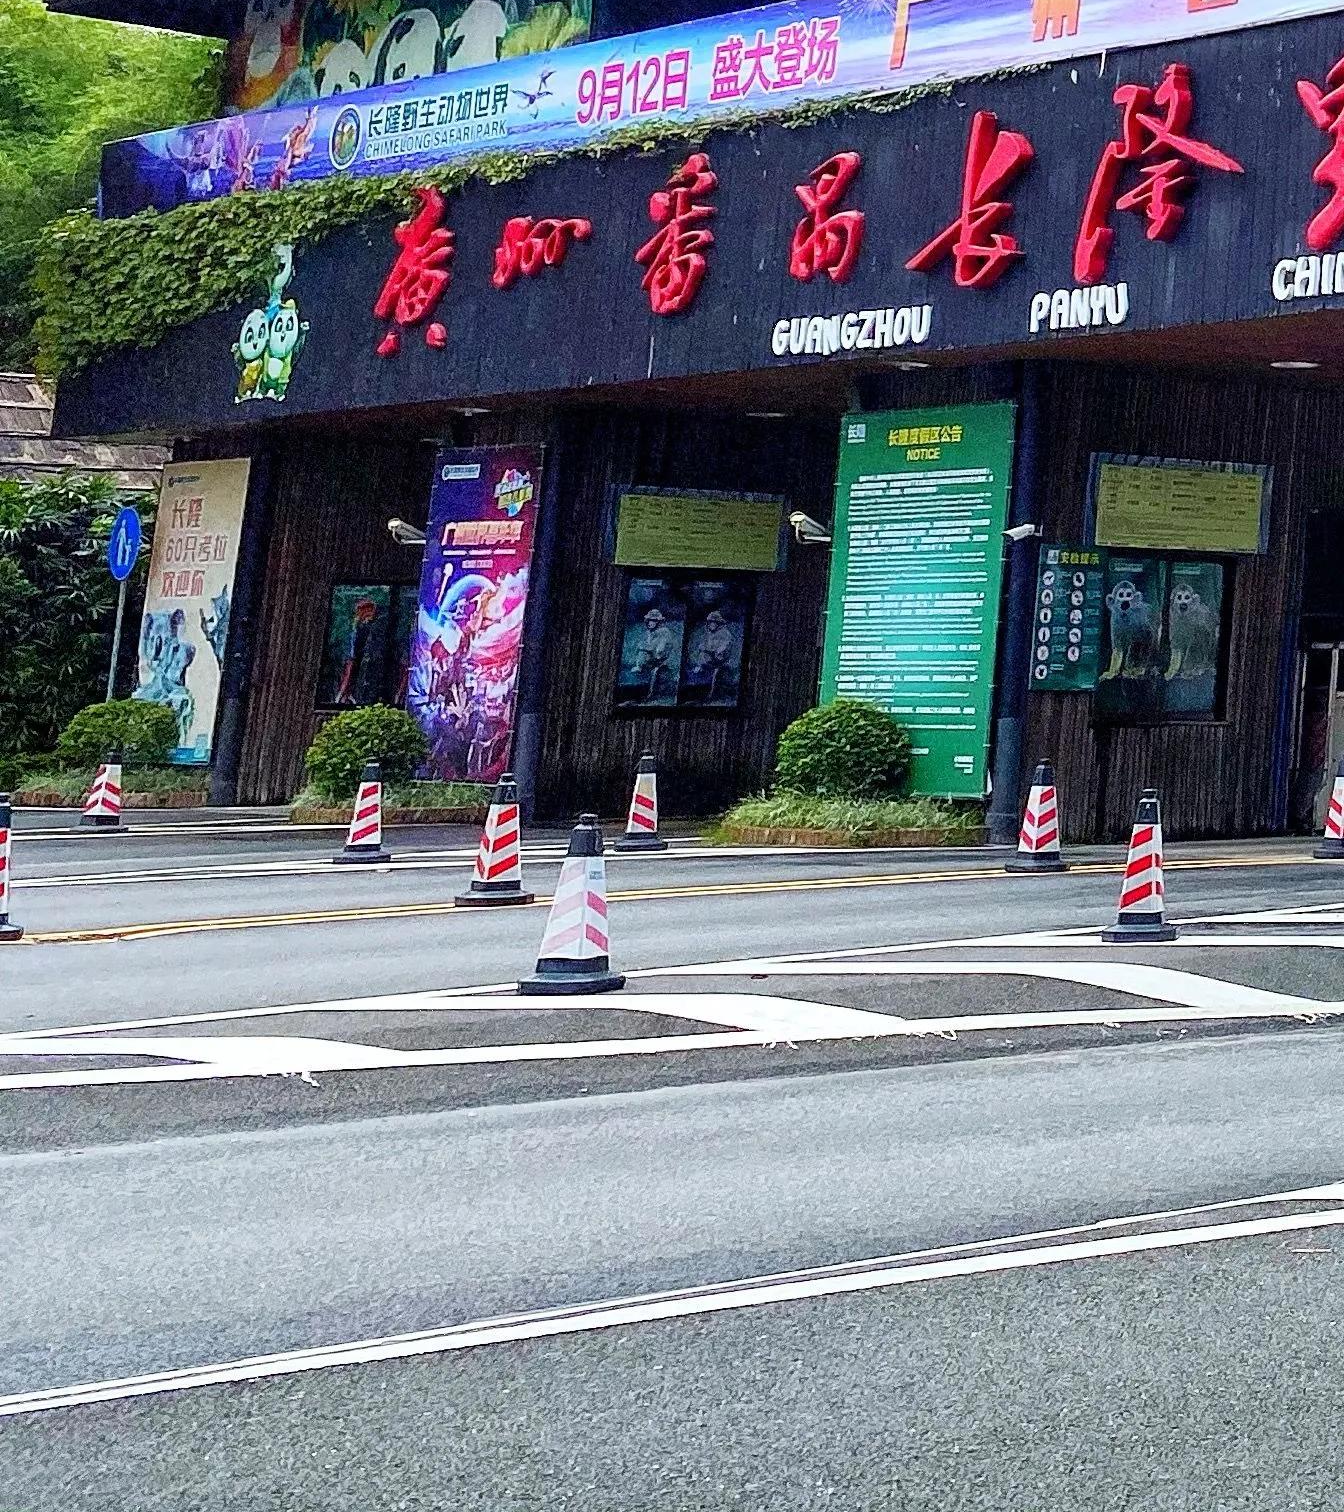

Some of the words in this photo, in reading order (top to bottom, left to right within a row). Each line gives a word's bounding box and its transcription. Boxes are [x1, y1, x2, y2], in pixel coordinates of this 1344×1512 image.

[577, 49, 690, 124] 9月12日
[709, 18, 840, 101] 盛大登场
[368, 83, 509, 138] 长隆野生动物世界
[366, 134, 431, 158] CHIMELONG
[433, 127, 474, 148] SAFARI
[476, 120, 507, 138] PARK
[771, 304, 933, 356] GUANGZHOU
[1029, 282, 1130, 334] PANYU
[906, 448, 941, 461] NOTICE
